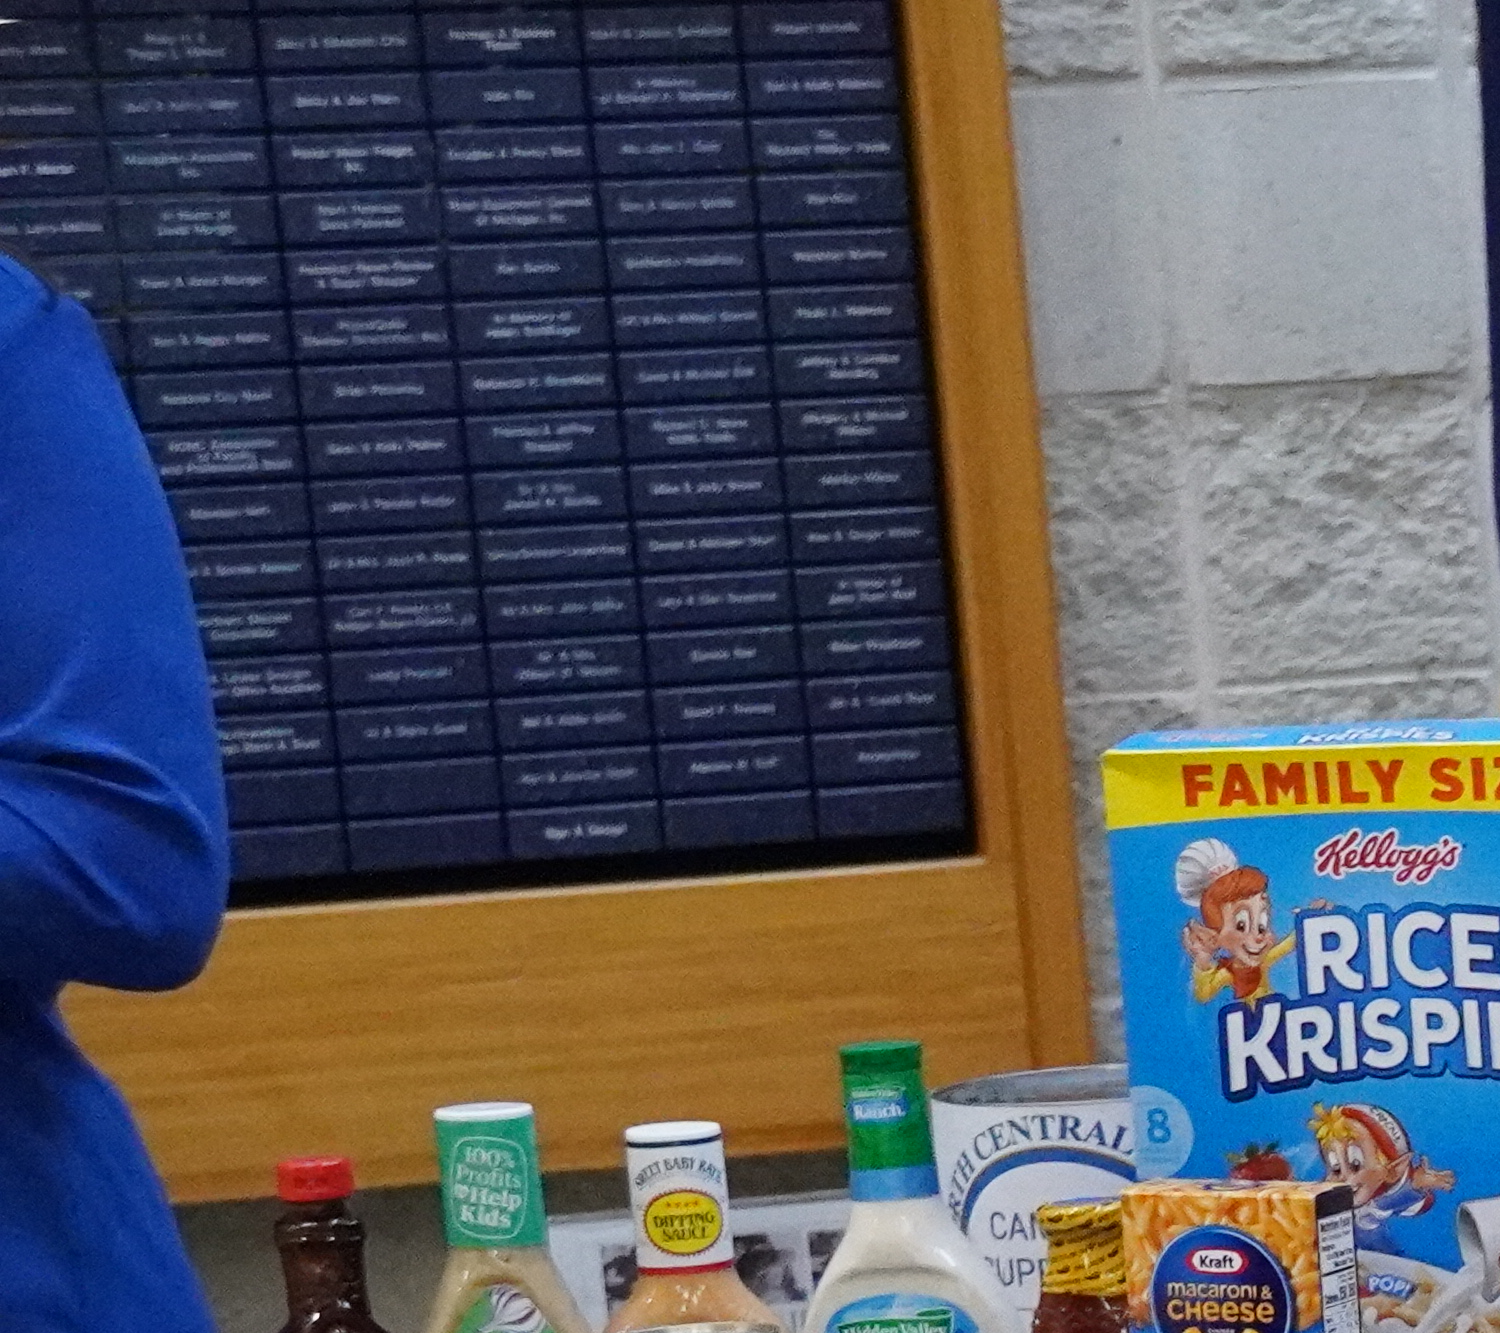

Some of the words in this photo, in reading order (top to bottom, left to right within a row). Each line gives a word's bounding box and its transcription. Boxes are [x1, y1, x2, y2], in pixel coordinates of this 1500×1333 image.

[1181, 757, 1405, 808] FAMILY
[1314, 828, 1464, 884] Kellogg's
[974, 1113, 1134, 1160] CENTRAL
[461, 1205, 512, 1228] Kids
[1198, 1255, 1235, 1270] Kraft
[1167, 1280, 1257, 1300] macaroni
